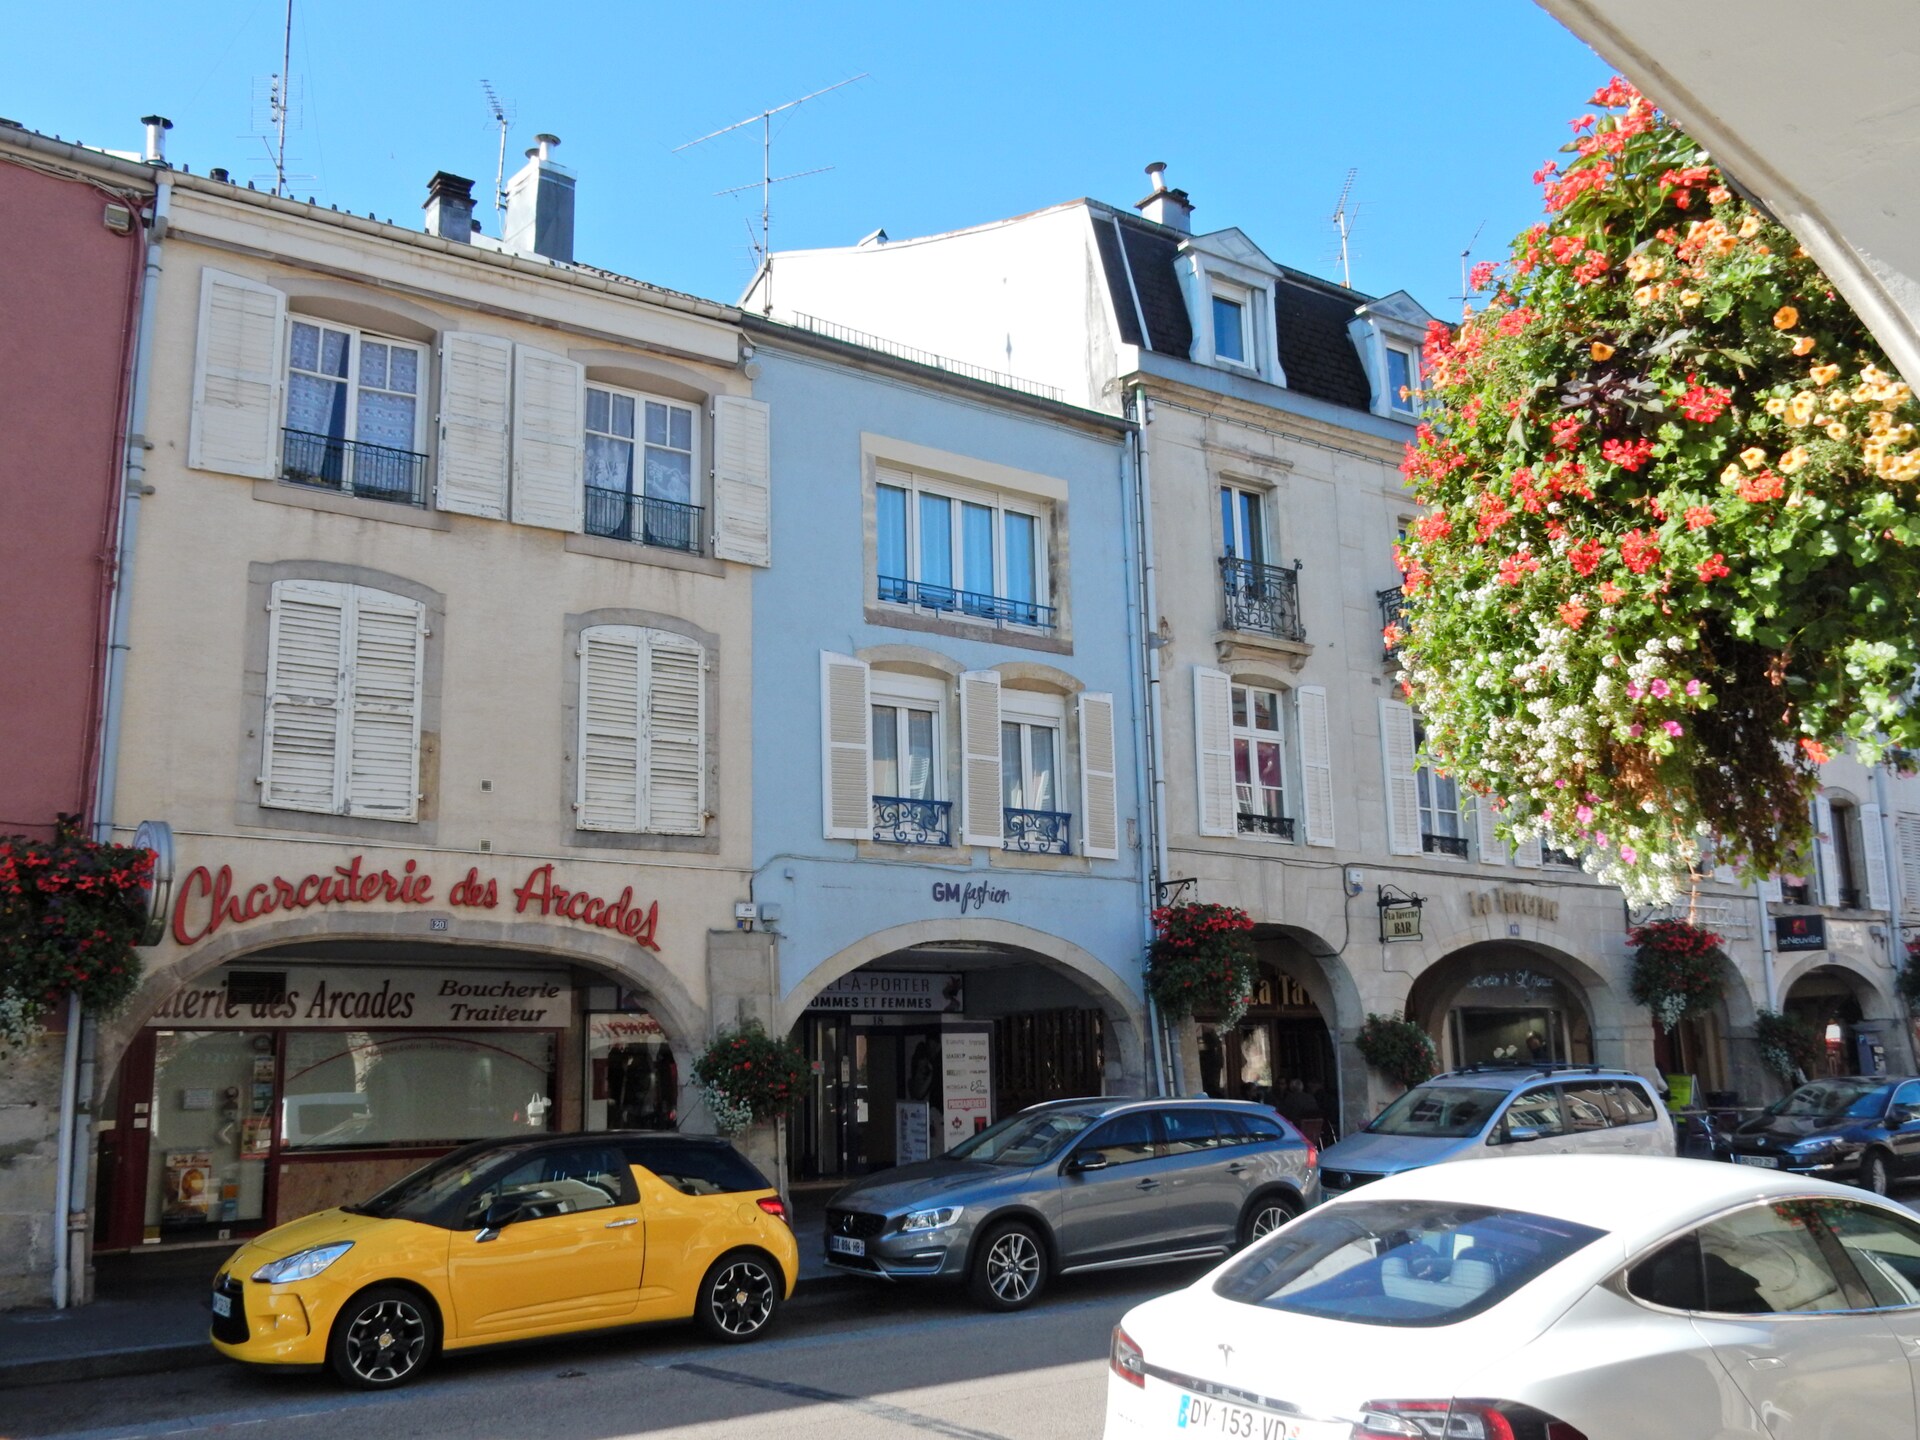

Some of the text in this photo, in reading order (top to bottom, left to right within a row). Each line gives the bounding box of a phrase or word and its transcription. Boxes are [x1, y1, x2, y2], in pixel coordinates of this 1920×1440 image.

[173, 855, 661, 952] Charcuterie des Arcades
[932, 880, 1011, 914] GM fashion
[432, 920, 446, 929] 20
[1394, 922, 1412, 934] BAR
[438, 980, 560, 998] Boucherie
[304, 979, 415, 1019] Arcades
[807, 996, 932, 1009] OMMES ET FEMMES
[450, 1003, 547, 1022] Traiteur
[873, 1016, 884, 1025] 18
